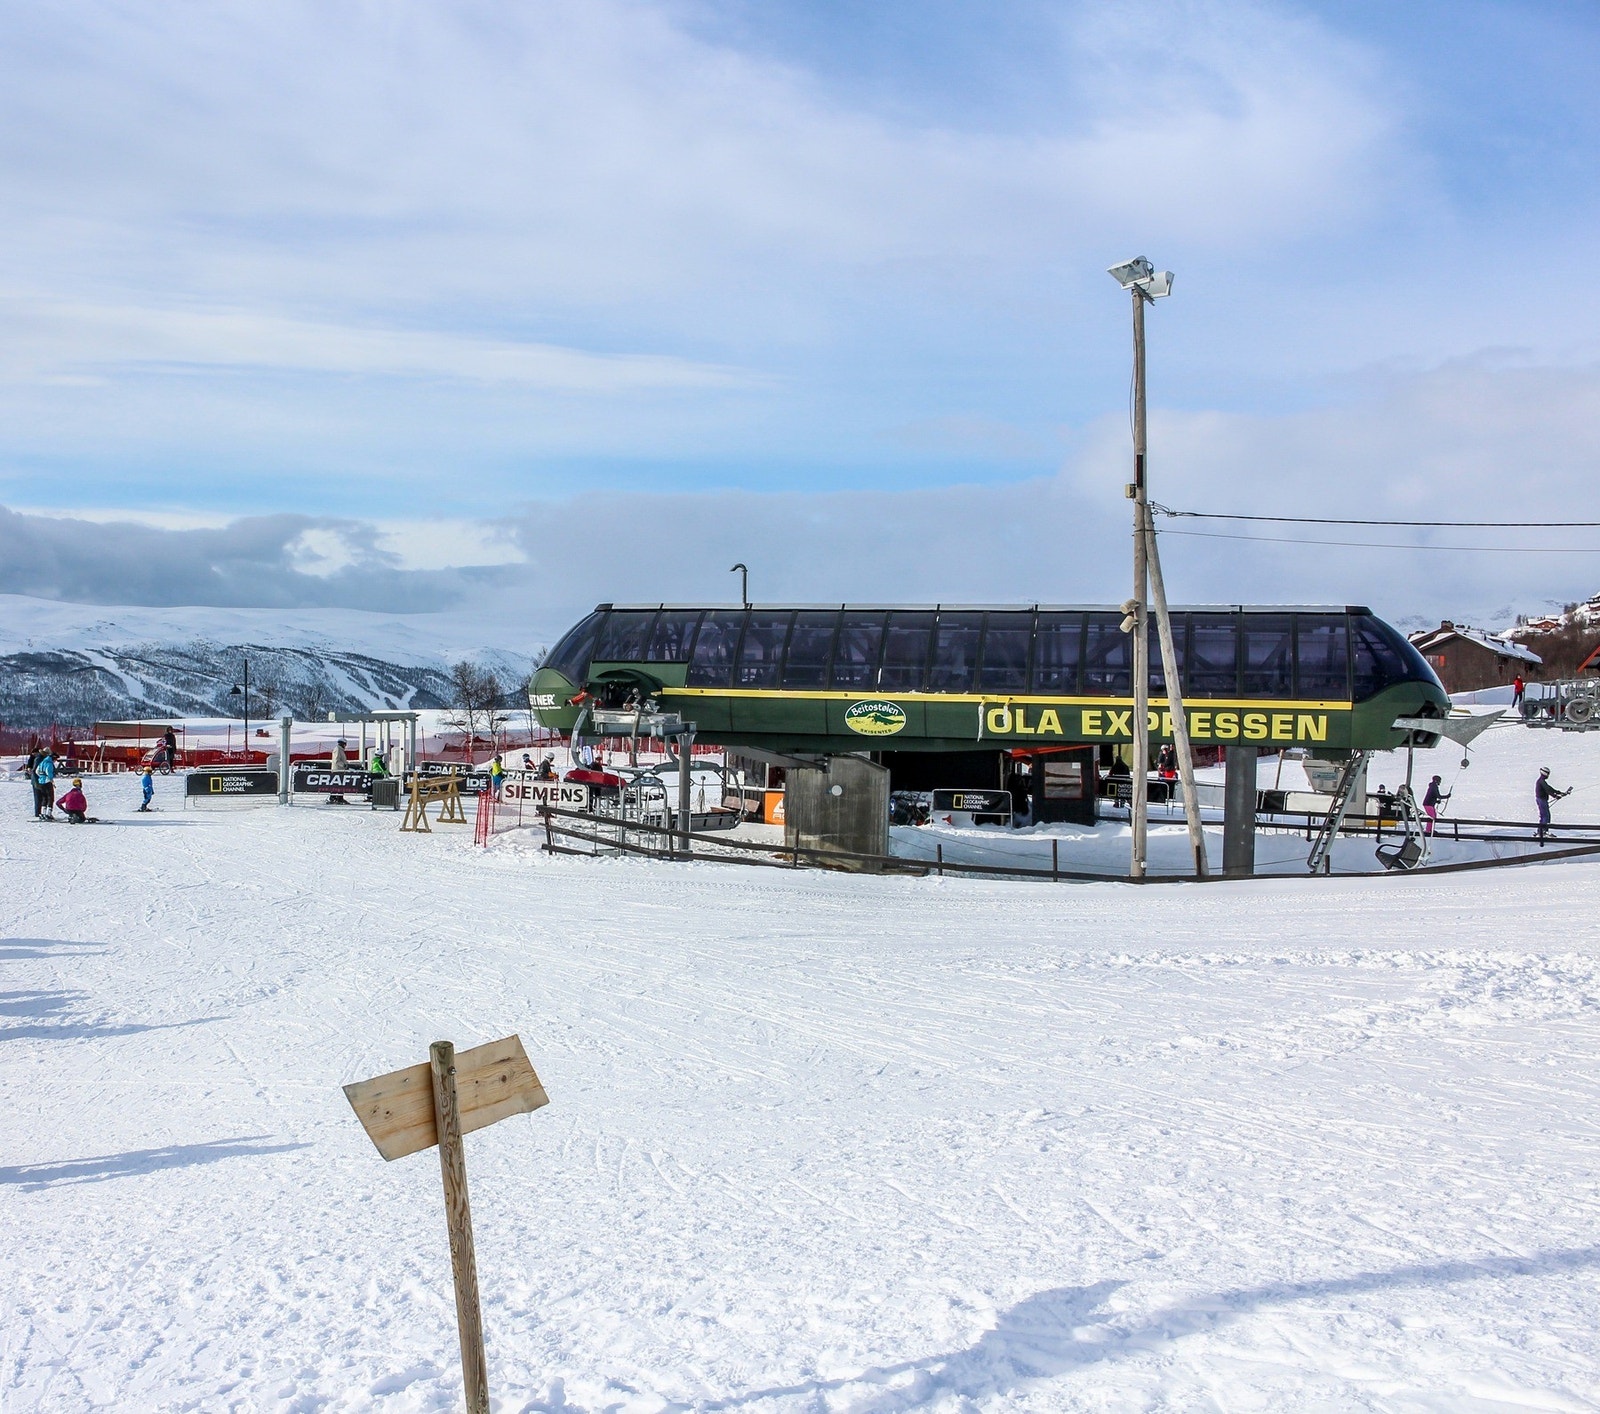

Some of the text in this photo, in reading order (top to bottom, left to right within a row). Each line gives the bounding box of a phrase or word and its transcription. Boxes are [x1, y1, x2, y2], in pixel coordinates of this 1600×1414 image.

[851, 703, 899, 717] Beitostølen
[987, 708, 1063, 735] OLA
[306, 774, 361, 786] CRAFT
[466, 776, 487, 787] IDÉ
[505, 785, 583, 802] SIEMENS
